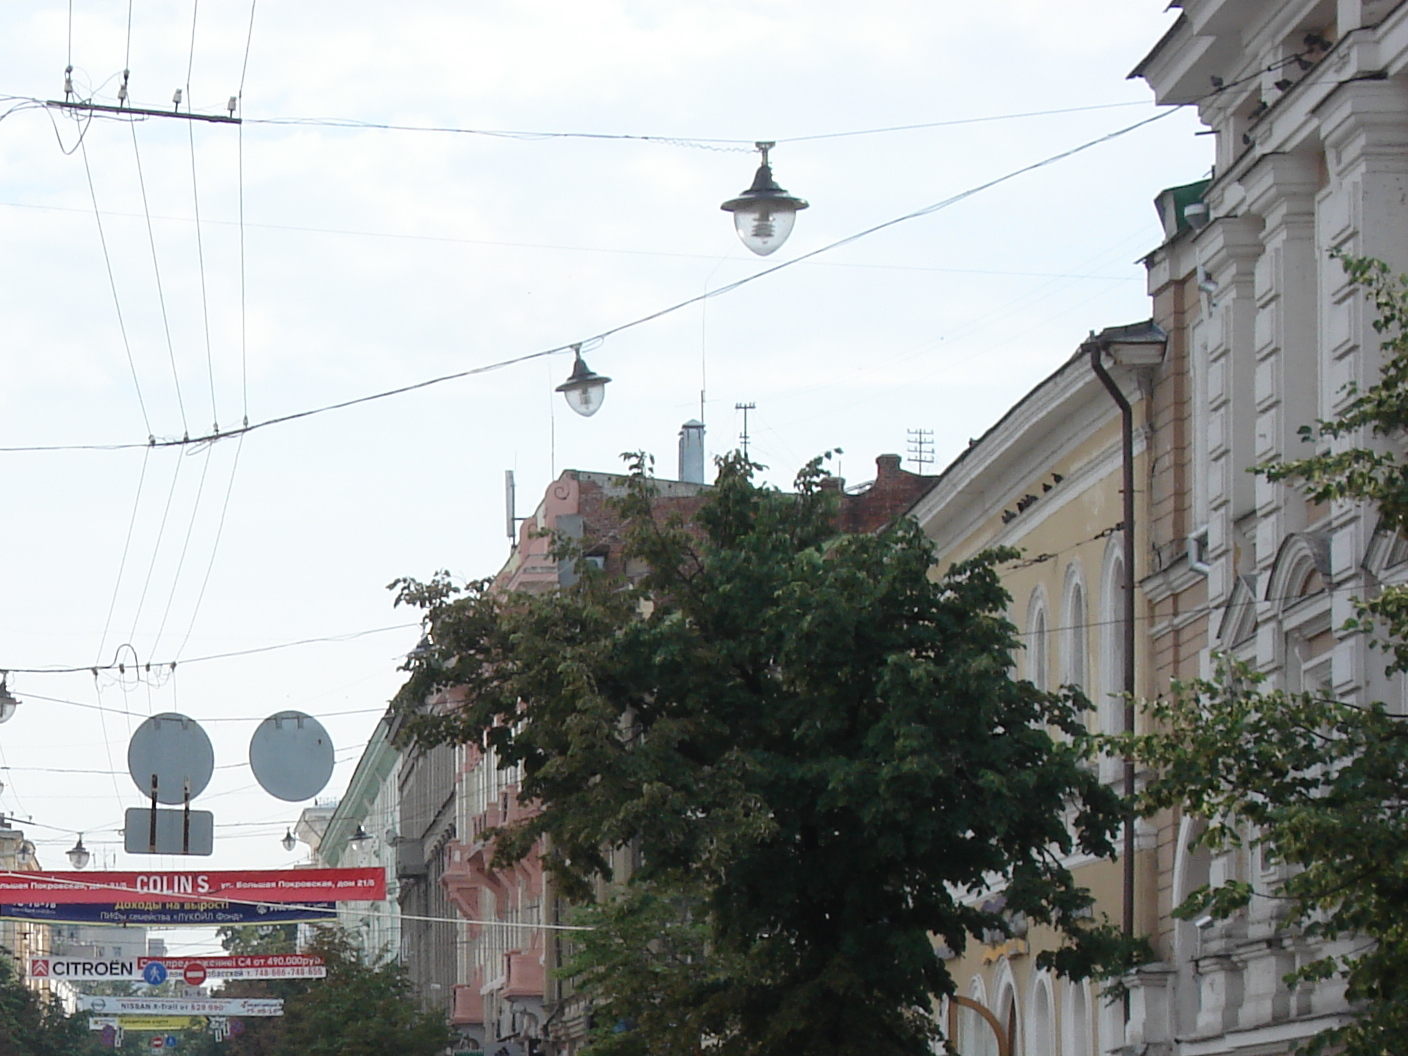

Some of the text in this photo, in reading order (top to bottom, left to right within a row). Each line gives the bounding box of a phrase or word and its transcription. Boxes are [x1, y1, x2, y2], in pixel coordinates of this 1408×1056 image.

[166, 902, 181, 910] на
[253, 958, 266, 966] от
[52, 960, 133, 976] CITROËN
